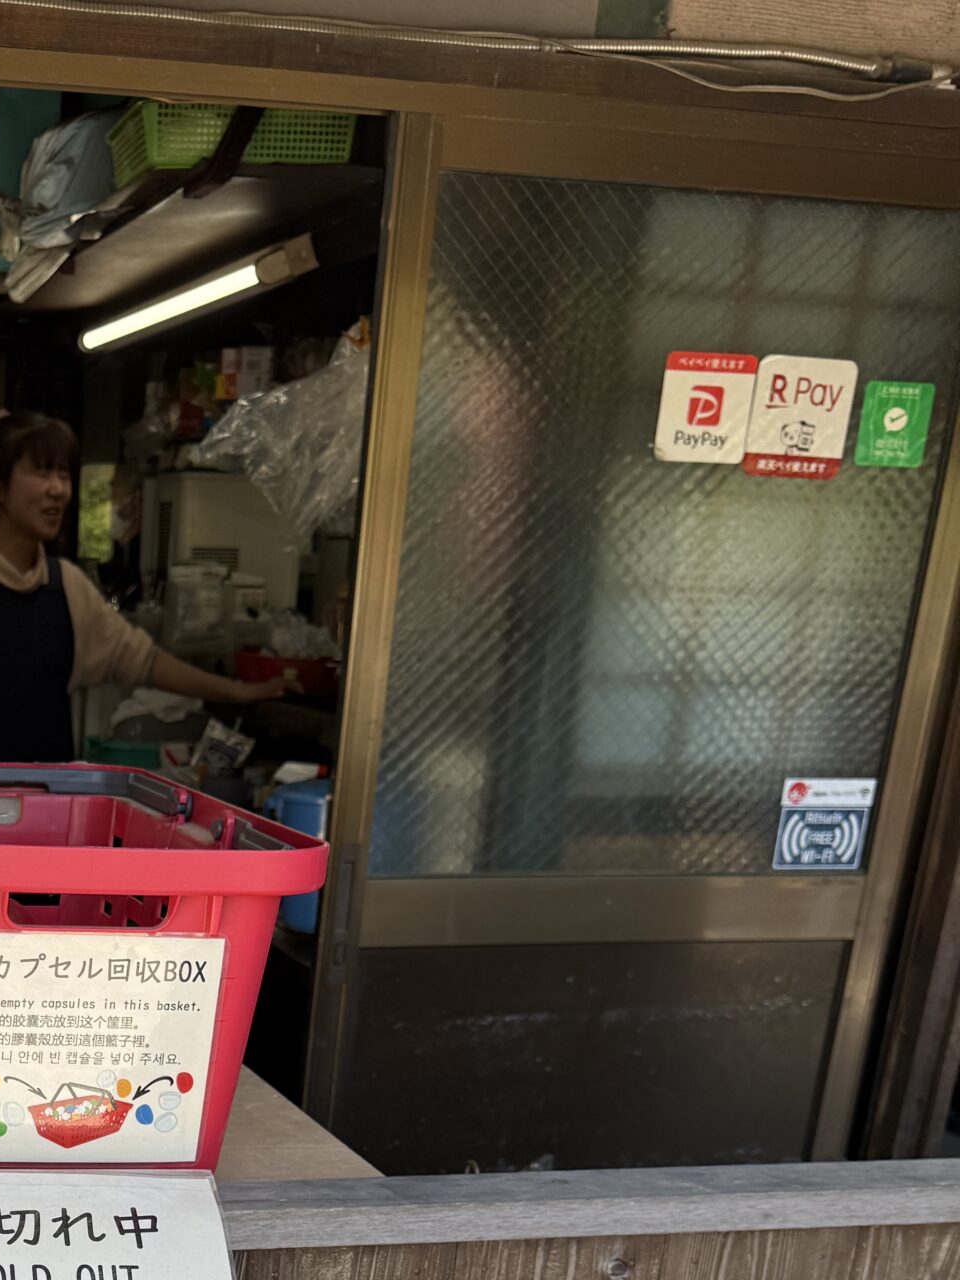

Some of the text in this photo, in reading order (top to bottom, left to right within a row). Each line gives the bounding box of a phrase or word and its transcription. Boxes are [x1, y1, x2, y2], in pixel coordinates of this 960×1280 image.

[794, 377, 844, 412] Pay
[673, 429, 729, 450] PayPay
[0, 998, 35, 1010] empty
[41, 998, 96, 1010] capsules
[104, 998, 116, 1009] in
[124, 999, 150, 1011] this
[156, 1000, 201, 1012] basket.
[18, 1050, 44, 1064] 안에
[49, 1051, 61, 1064] 빈
[65, 1051, 106, 1065] 캡슐을
[110, 1052, 135, 1066] 넣어
[139, 1053, 182, 1066] 주세요.
